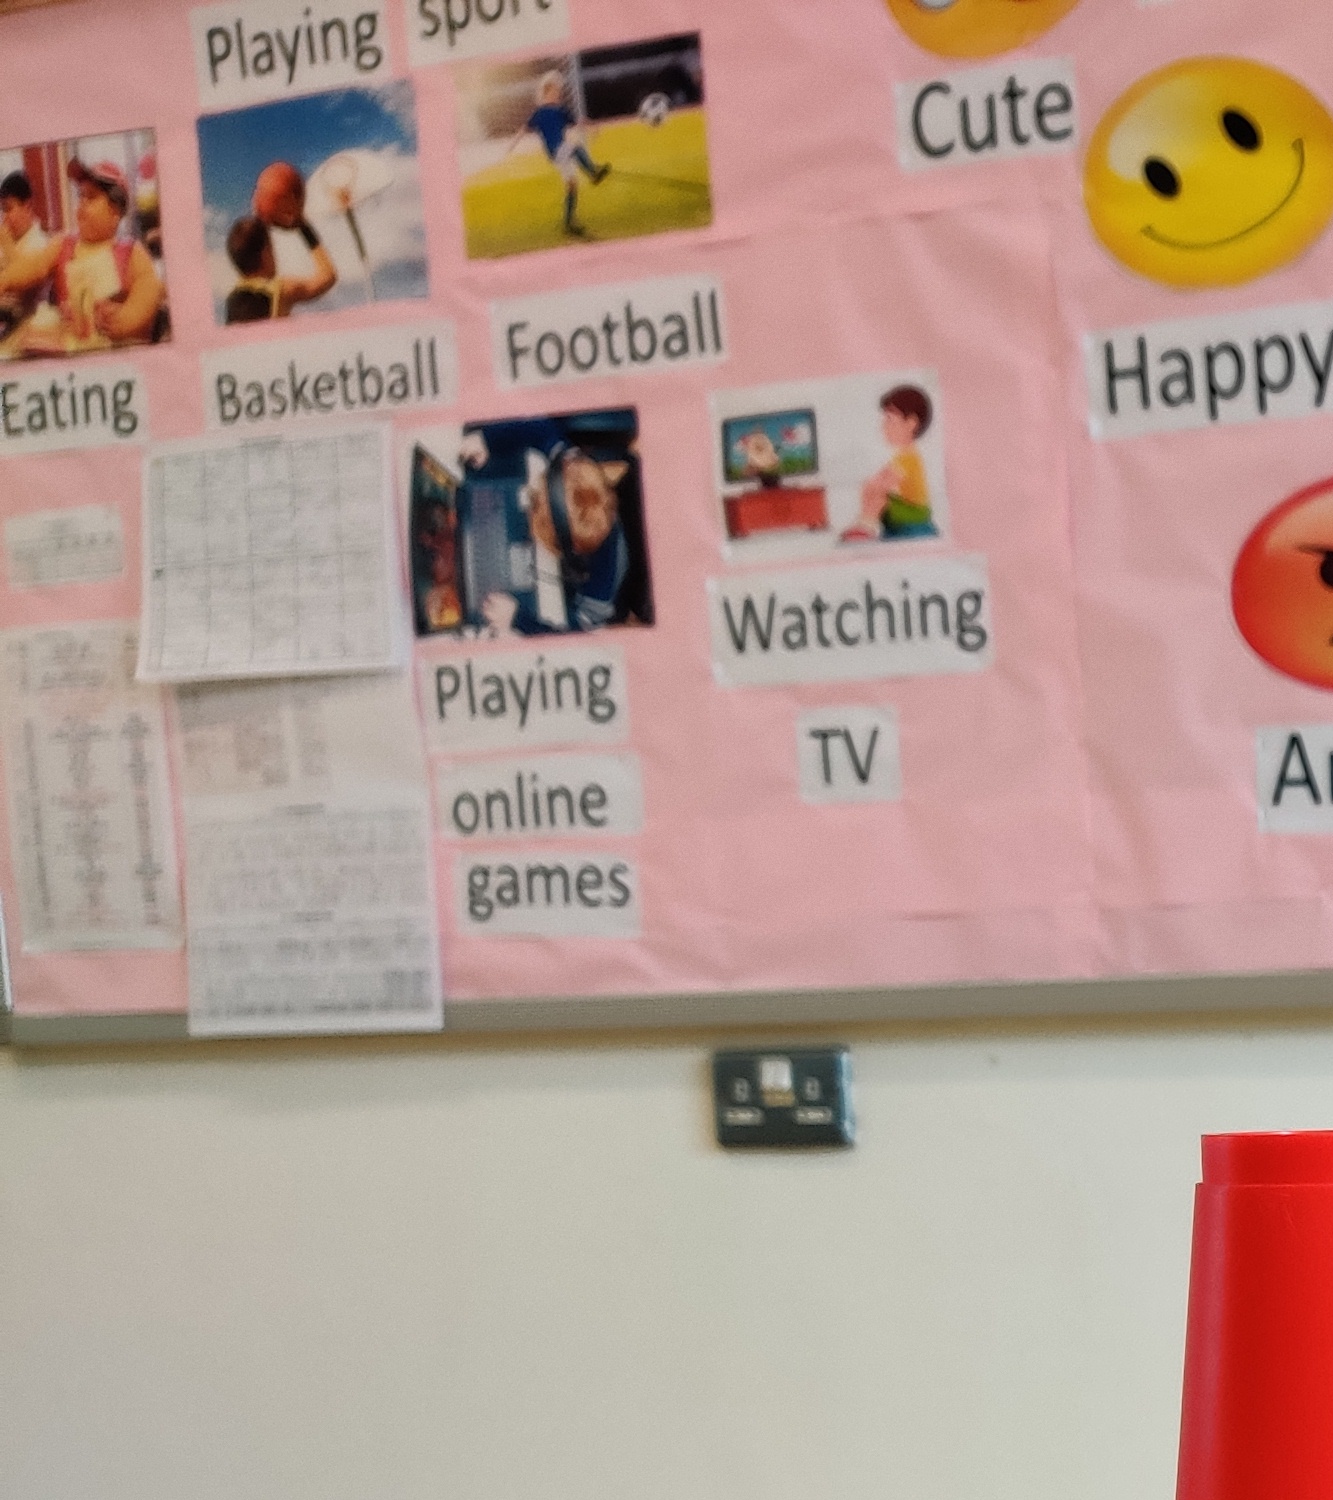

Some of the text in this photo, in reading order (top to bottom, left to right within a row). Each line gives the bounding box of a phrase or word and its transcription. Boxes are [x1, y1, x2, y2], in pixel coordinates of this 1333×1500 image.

[205, 0, 551, 86] Playing spo
[911, 74, 1075, 159] Cute
[505, 289, 723, 381] Football
[1, 371, 138, 437] Eating
[216, 337, 441, 425] Basketball
[722, 580, 988, 655] Watching
[435, 655, 616, 730] Playing
[809, 726, 880, 785] TV
[451, 773, 608, 836] online
[466, 860, 632, 922] games
